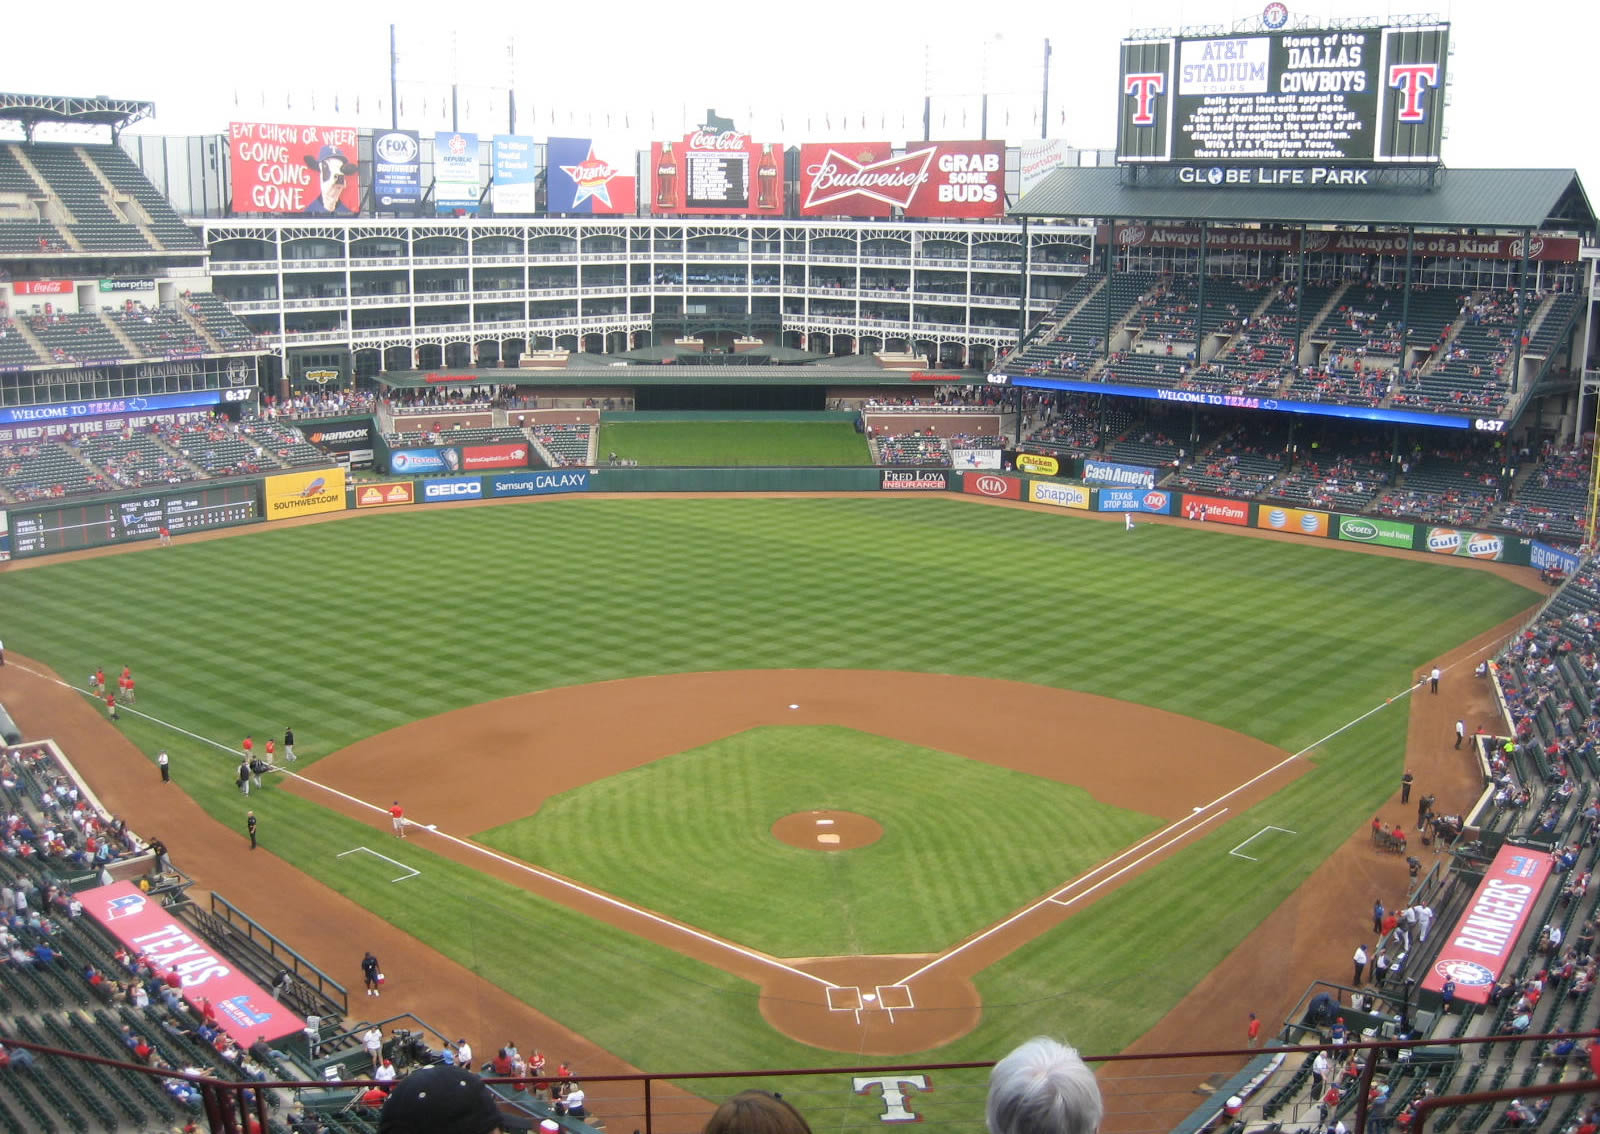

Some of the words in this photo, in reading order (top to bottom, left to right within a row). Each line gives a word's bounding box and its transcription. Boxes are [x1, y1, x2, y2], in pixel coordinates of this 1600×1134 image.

[1282, 36, 1320, 48] Home
[1323, 34, 1338, 46] of
[1342, 33, 1365, 46] the
[1202, 41, 1248, 60] AT&T
[1288, 47, 1362, 69] DALLAS
[1184, 62, 1265, 83] STADIUM
[1280, 70, 1366, 93] COWBOYS
[1124, 72, 1165, 125] T
[1389, 63, 1439, 121] T
[1204, 96, 1226, 106] Daily
[1229, 96, 1253, 104] tours
[1256, 96, 1275, 104] that
[1278, 95, 1296, 103] will
[1298, 94, 1330, 104] appeal
[1333, 94, 1344, 102] to
[1197, 106, 1227, 114] people
[1230, 104, 1239, 112] of
[1242, 104, 1253, 112] all
[1256, 104, 1298, 112] interests
[1300, 104, 1318, 112] and
[1321, 104, 1347, 113] ages.
[1189, 114, 1210, 122] Take
[1226, 114, 1271, 122] afternoon
[1318, 113, 1334, 121] the
[1336, 112, 1355, 120] ball
[1196, 124, 1211, 132] the
[1213, 123, 1234, 131] field
[1302, 122, 1331, 130] works
[1334, 122, 1344, 130] of
[1346, 122, 1362, 130] art
[232, 124, 256, 139] EAT
[260, 123, 298, 144] CHIKIN
[302, 127, 318, 144] OR
[322, 130, 356, 146] WEER
[1191, 132, 1233, 141] displayed
[1236, 132, 1288, 142] throughout
[1290, 132, 1306, 140] the
[1309, 131, 1350, 140] stadium.
[386, 140, 408, 152] FOX
[1204, 140, 1226, 149] With
[1264, 140, 1302, 148] Stadium
[1304, 140, 1335, 150] Tours,
[240, 142, 288, 163] GOING
[1194, 150, 1218, 158] there
[1231, 149, 1278, 158] something
[1281, 149, 1295, 157] for
[1298, 150, 1345, 158] everyone.
[938, 154, 1000, 172] GRAB
[1022, 152, 1062, 175] SportsDay
[258, 163, 311, 186] GOING
[573, 162, 612, 182] Ozarka
[806, 164, 928, 190] Budweiser
[949, 172, 988, 184] SOME
[1180, 167, 1251, 184] GLOBE
[1258, 168, 1304, 184] LIFE
[1311, 167, 1368, 184] PARK
[252, 185, 306, 210] GONE
[938, 184, 998, 202] BUDS
[1150, 230, 1199, 244] Always
[1232, 232, 1244, 244] of
[1246, 236, 1254, 244] a
[1256, 232, 1292, 246] Kind
[1336, 235, 1392, 252] Always
[1428, 238, 1444, 252] of
[1447, 242, 1455, 252] a
[1459, 240, 1500, 254] Kind
[102, 280, 154, 290] enterprise
[38, 371, 64, 385] JACK
[140, 364, 164, 378] JACK
[987, 373, 1008, 384] 6:37
[226, 390, 252, 402] 6:37
[1158, 389, 1206, 404] WELCOME
[1208, 394, 1222, 405] TO
[1224, 396, 1260, 409] TEXAS
[11, 406, 68, 420] WELCOME
[72, 405, 86, 416] TO
[88, 400, 126, 414] TEXAS
[70, 421, 103, 434] TIRE
[1475, 419, 1504, 432] 6:37
[1022, 456, 1052, 467] Chicken
[496, 481, 534, 491] Samsung
[536, 474, 586, 488] GALAXY
[884, 470, 913, 481] FRED
[916, 470, 944, 481] LOYA
[426, 482, 481, 496] GEICO
[883, 481, 946, 489] INSURANCE
[981, 480, 1002, 492] KIA
[1036, 484, 1083, 505] Snapple
[1110, 492, 1132, 500] TEXAS
[1147, 494, 1164, 506] DQ
[143, 499, 160, 508] 6:37
[274, 494, 338, 510] SOUTHWEST.COM
[1104, 500, 1122, 509] STOP
[1122, 501, 1139, 509] SIGN
[1346, 524, 1374, 535] Scotts
[1430, 536, 1460, 548] Gulf
[1469, 542, 1500, 553] Gulf
[1454, 878, 1533, 957] RANGERS
[132, 924, 231, 988] TEXAS
[850, 1075, 935, 1124] T
